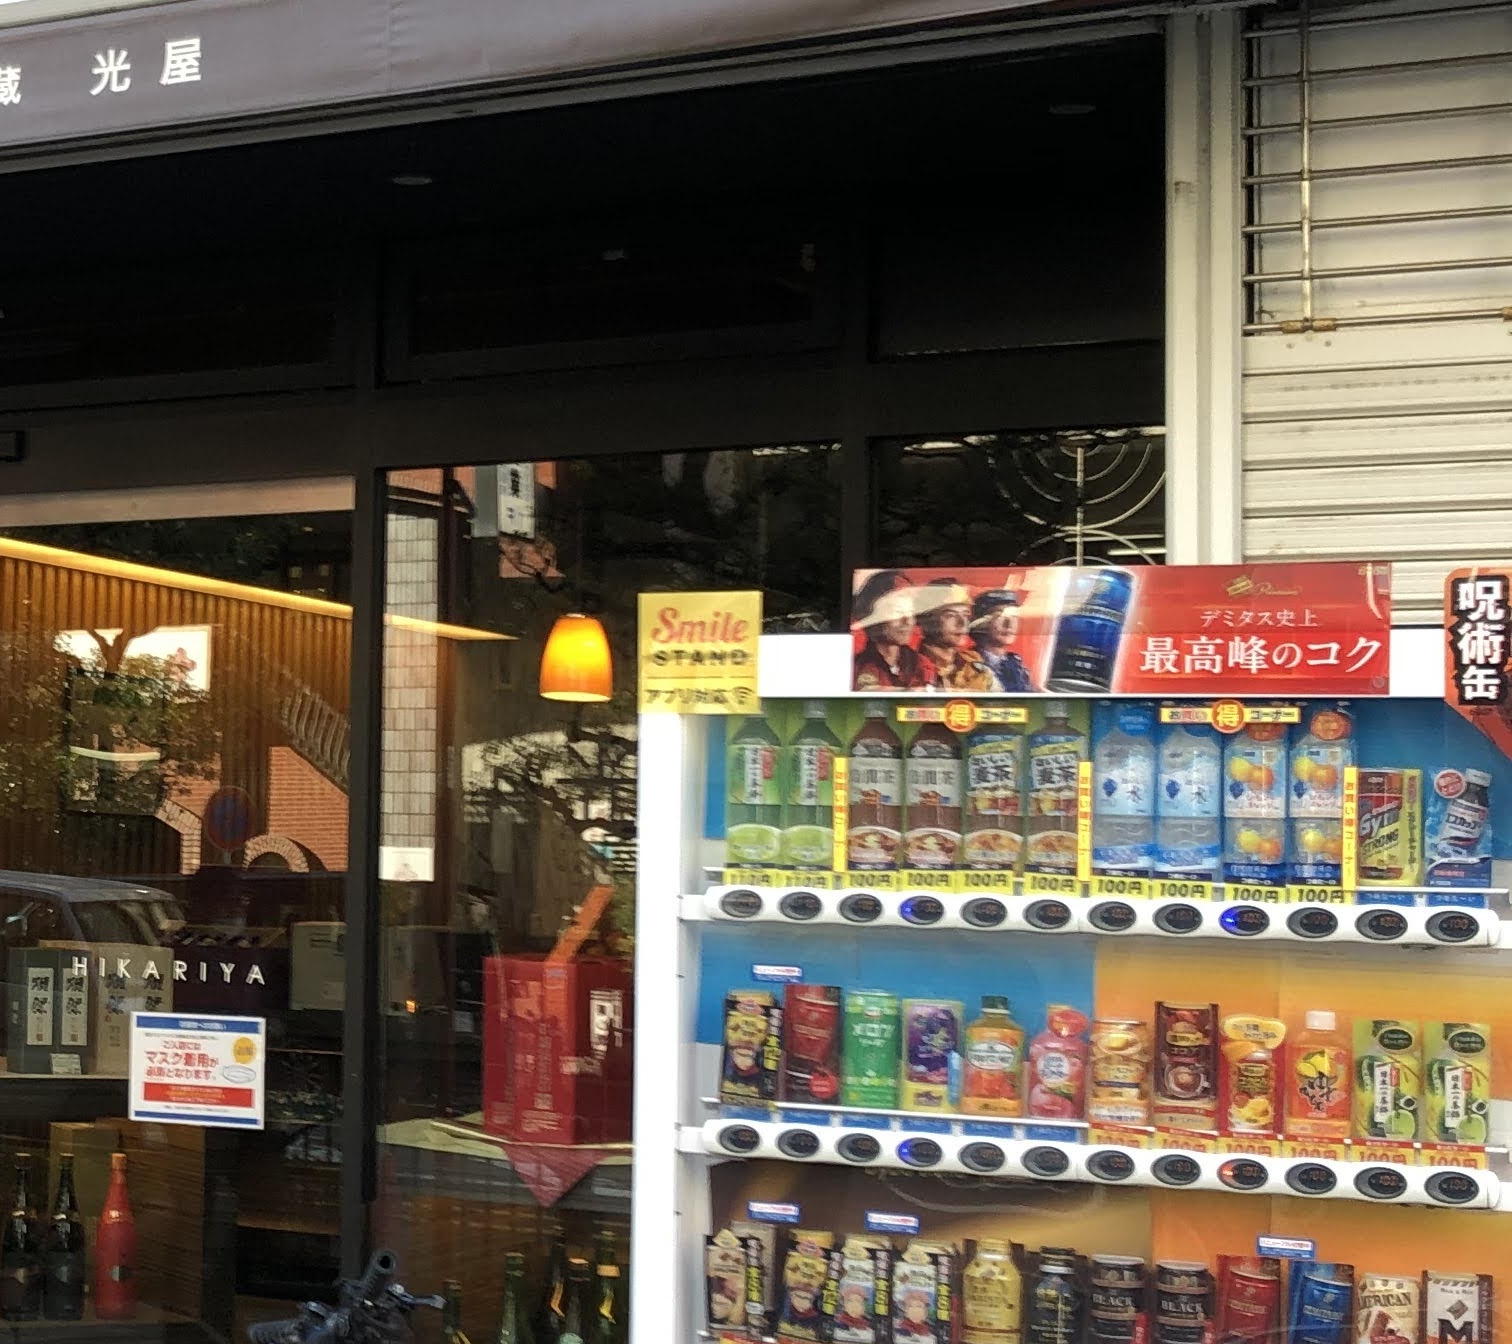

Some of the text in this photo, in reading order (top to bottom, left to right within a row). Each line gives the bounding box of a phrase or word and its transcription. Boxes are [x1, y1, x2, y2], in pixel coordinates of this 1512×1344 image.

[90, 37, 204, 96] 光屋
[651, 606, 749, 644] Smile
[1200, 607, 1321, 629] デミタス史上
[1139, 634, 1384, 676] 最高峰のコク
[1457, 578, 1505, 701] 呪術缶
[652, 648, 750, 666] STAND
[71, 955, 266, 986] HIKARIYA
[1093, 1292, 1135, 1308] BLACK
[1161, 1299, 1204, 1314] BLACK
